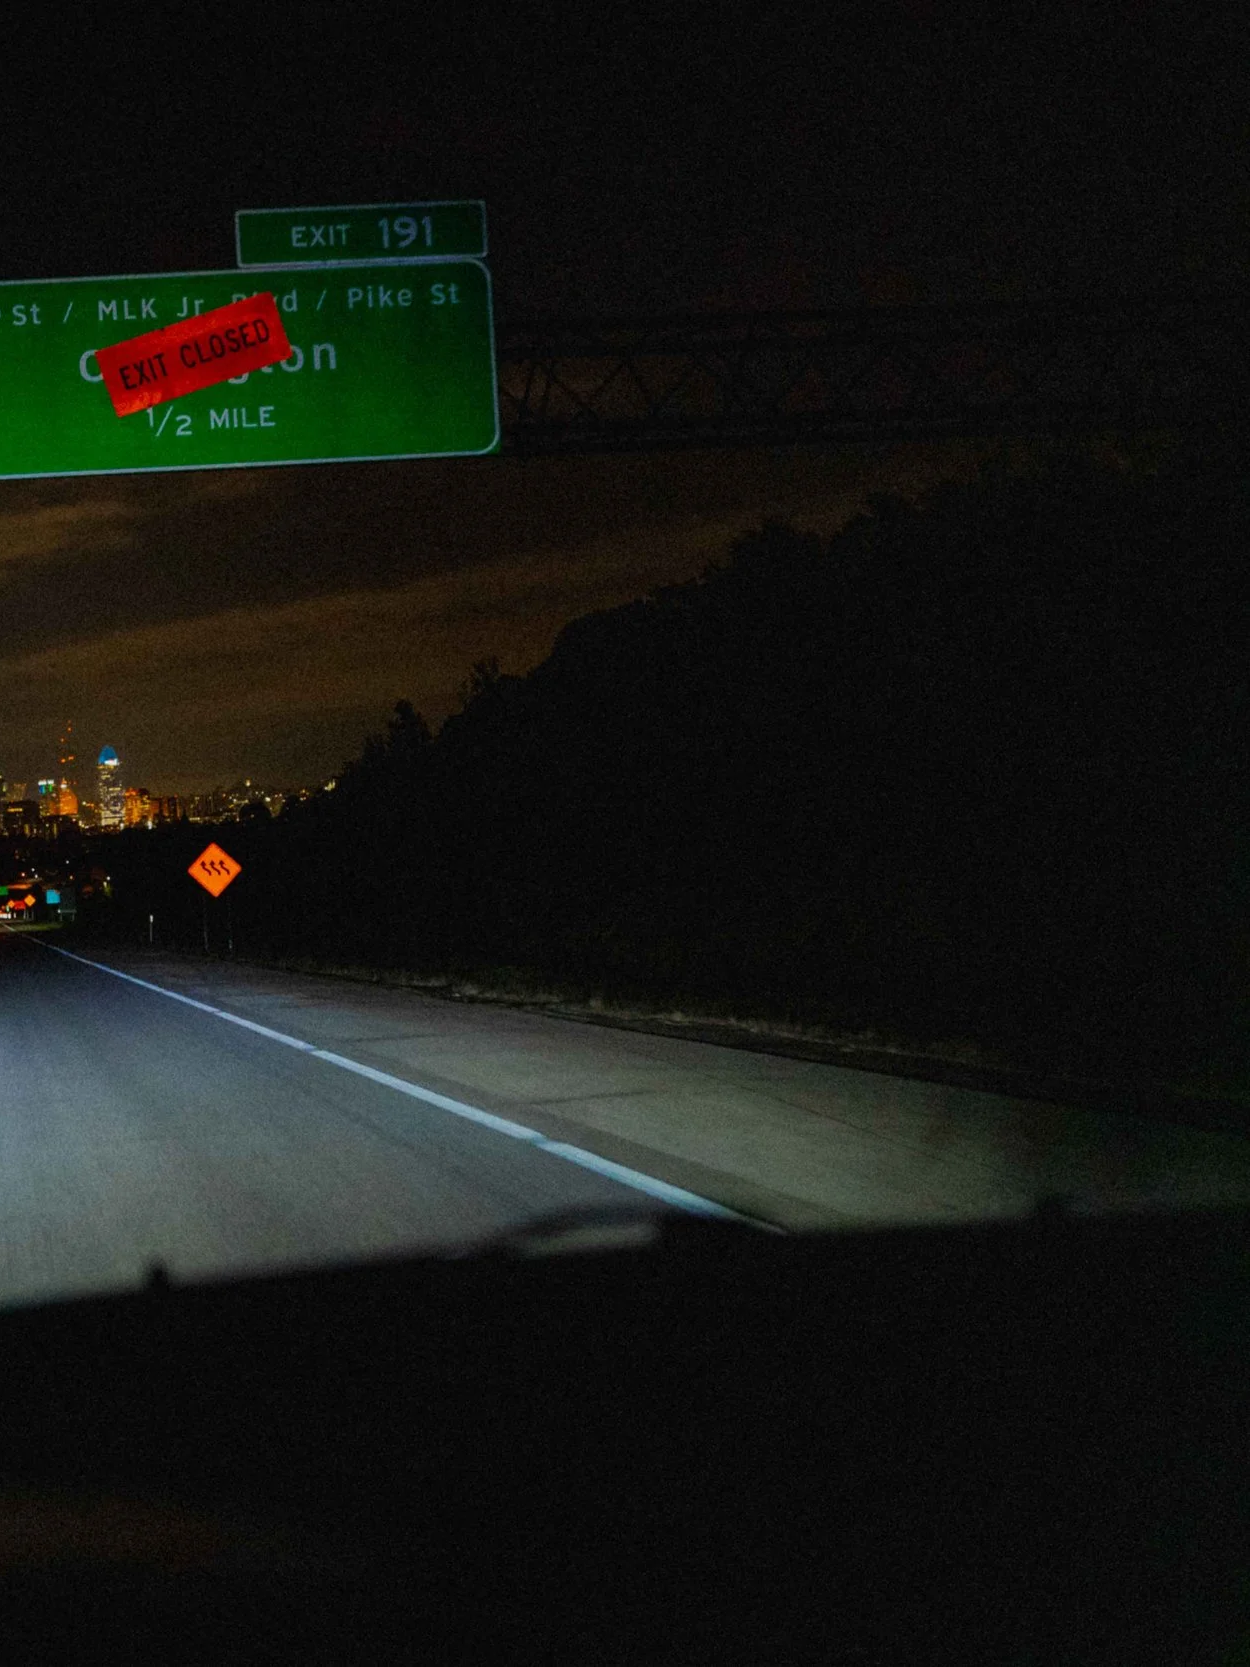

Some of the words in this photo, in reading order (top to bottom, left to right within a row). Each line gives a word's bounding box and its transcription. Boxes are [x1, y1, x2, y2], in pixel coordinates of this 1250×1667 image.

[291, 226, 351, 249] EXIT
[378, 216, 434, 249] 191
[12, 303, 41, 326] St
[62, 302, 74, 324] /
[98, 299, 157, 321] MLK
[176, 297, 205, 317] Jr
[316, 290, 327, 309] /
[348, 283, 414, 309] Pike
[431, 283, 459, 306] St
[118, 352, 168, 390] EXIT
[179, 319, 270, 369] CLOSED
[146, 406, 192, 437] 1/2
[209, 406, 276, 429] MILE
